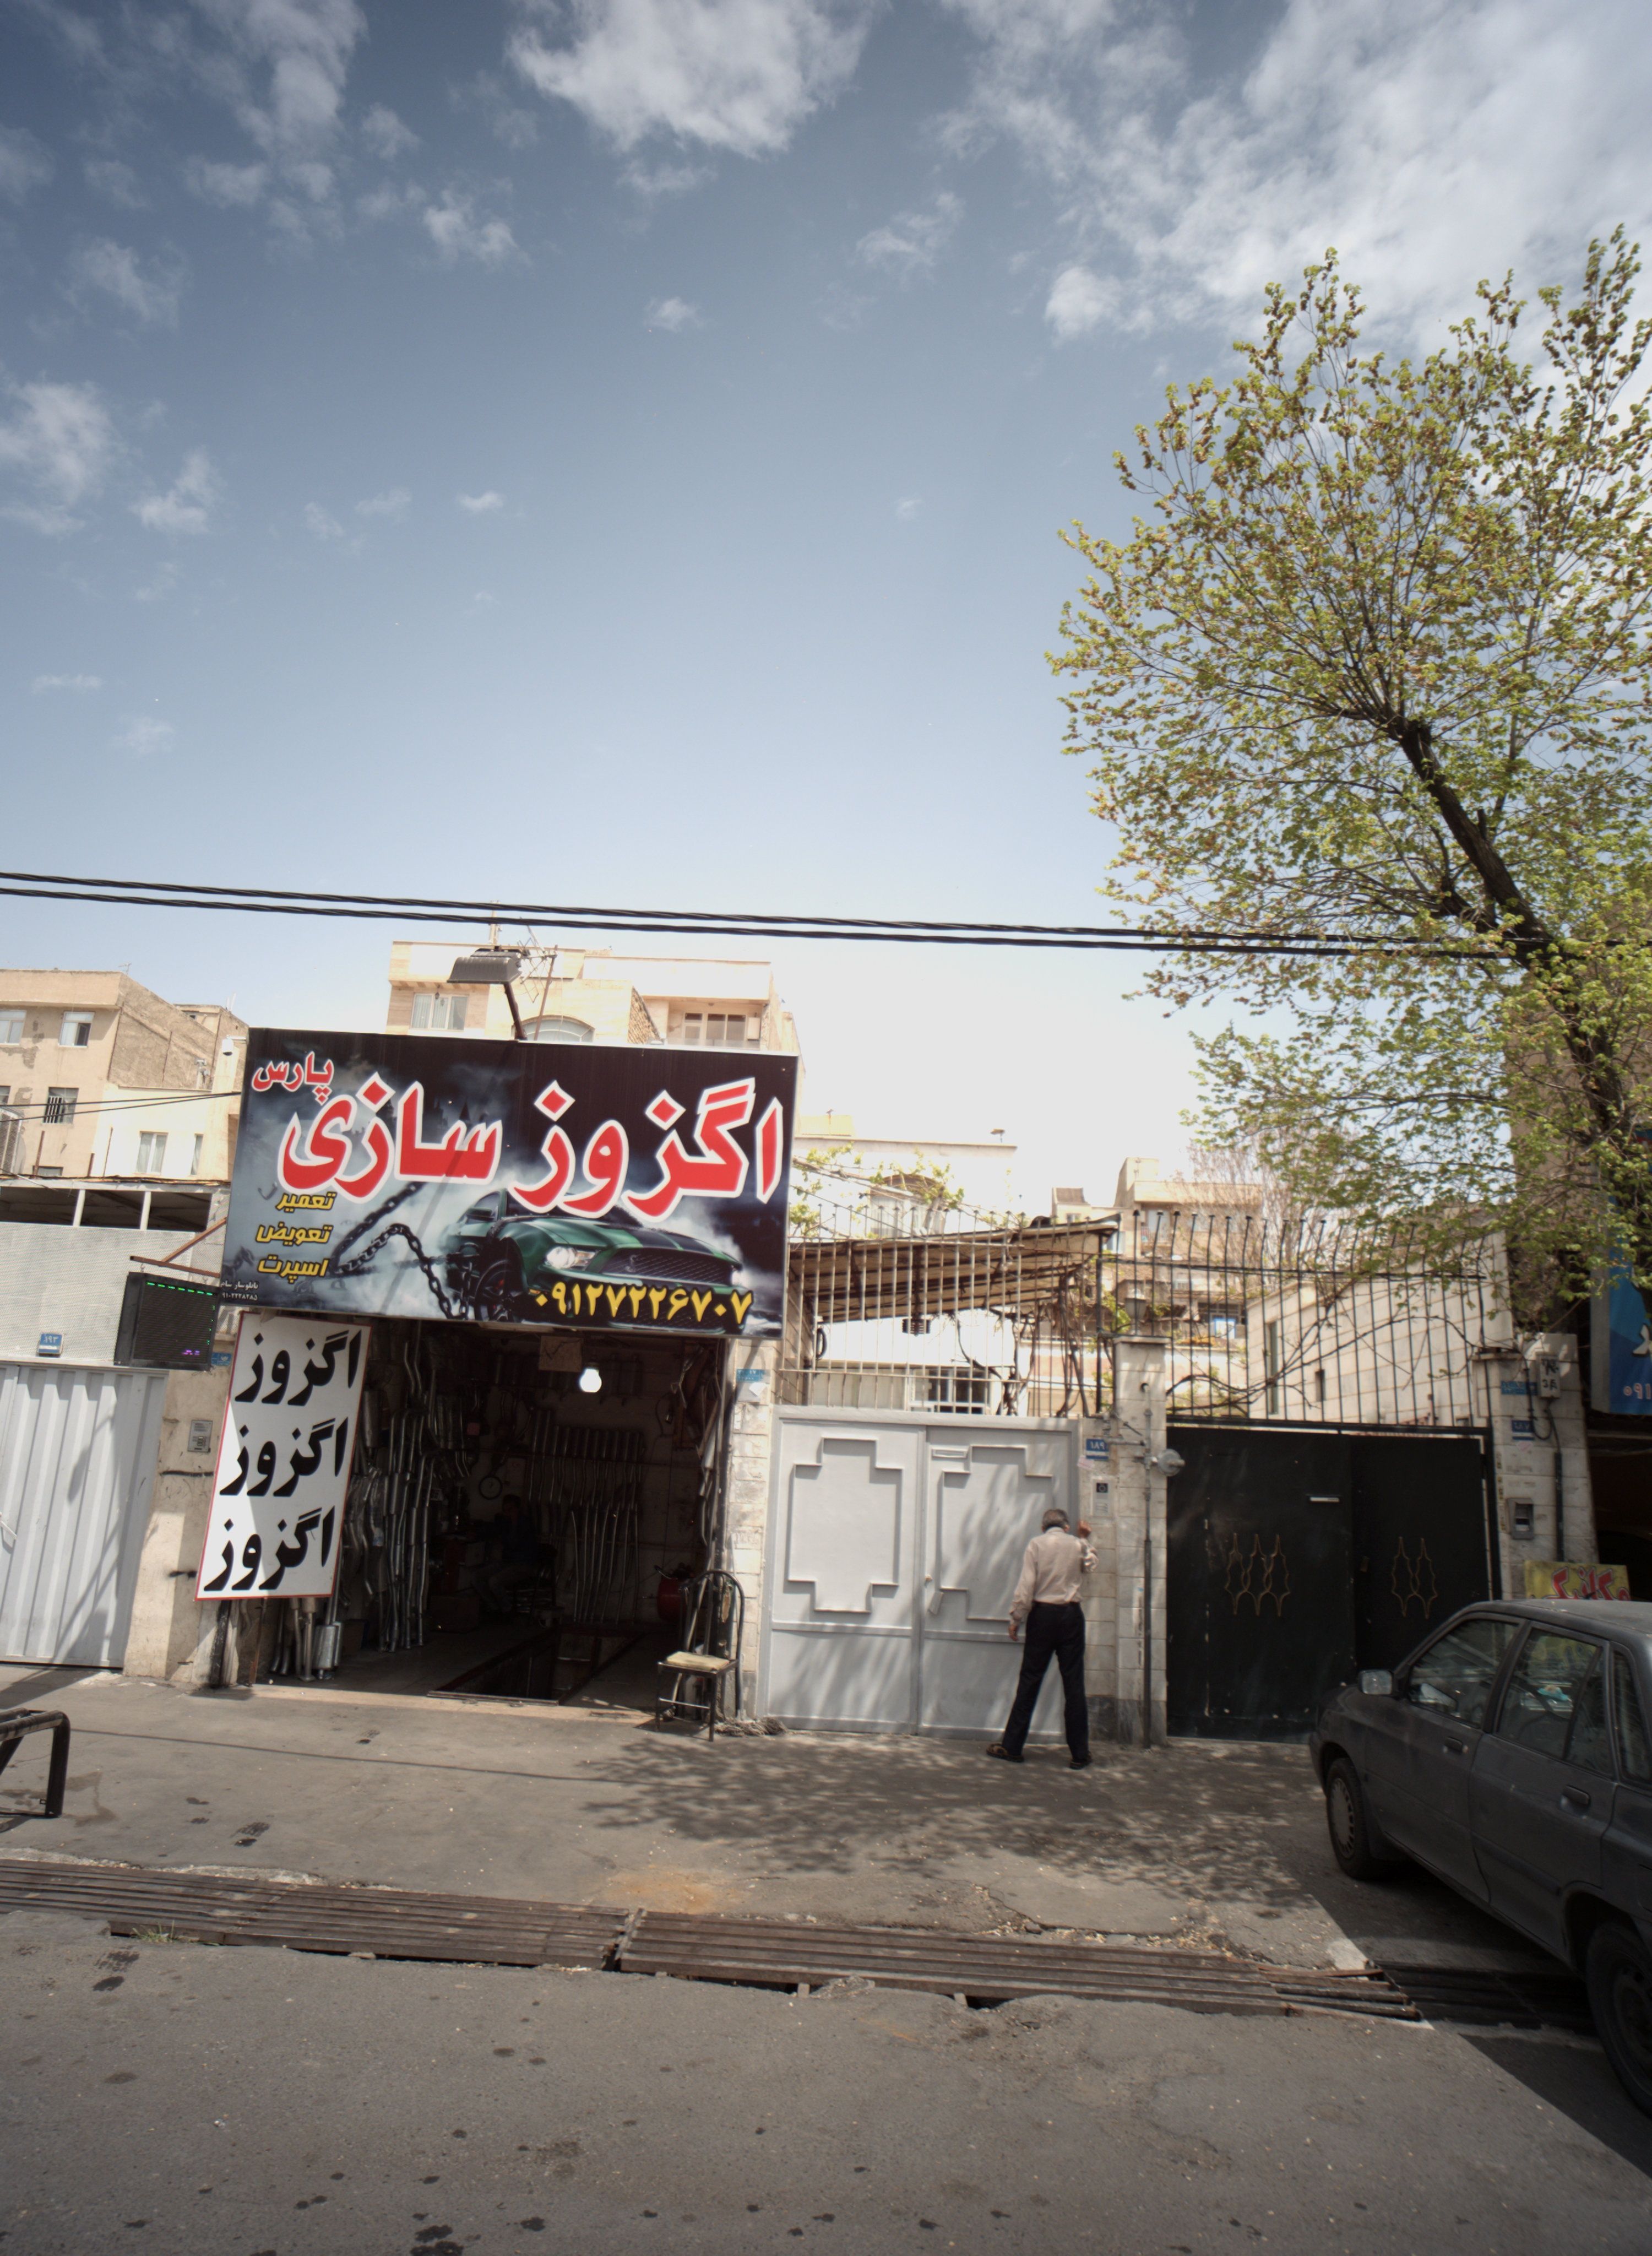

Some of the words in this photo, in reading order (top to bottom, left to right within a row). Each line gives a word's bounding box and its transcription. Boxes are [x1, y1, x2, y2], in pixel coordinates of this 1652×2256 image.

[252, 1051, 334, 1103] پارس
[277, 1071, 503, 1203] سازی
[509, 1077, 783, 1223] اگزوز
[256, 1221, 334, 1246] تعویض
[275, 1191, 338, 1213] تعمیر
[257, 1254, 330, 1284] اسپرت
[535, 1281, 753, 1324] ۰۹۱۲۷۲۲۶۷۰۷
[235, 1330, 362, 1407] اگزوز
[219, 1417, 349, 1497] اگزوز
[204, 1505, 335, 1591] اگزوز
